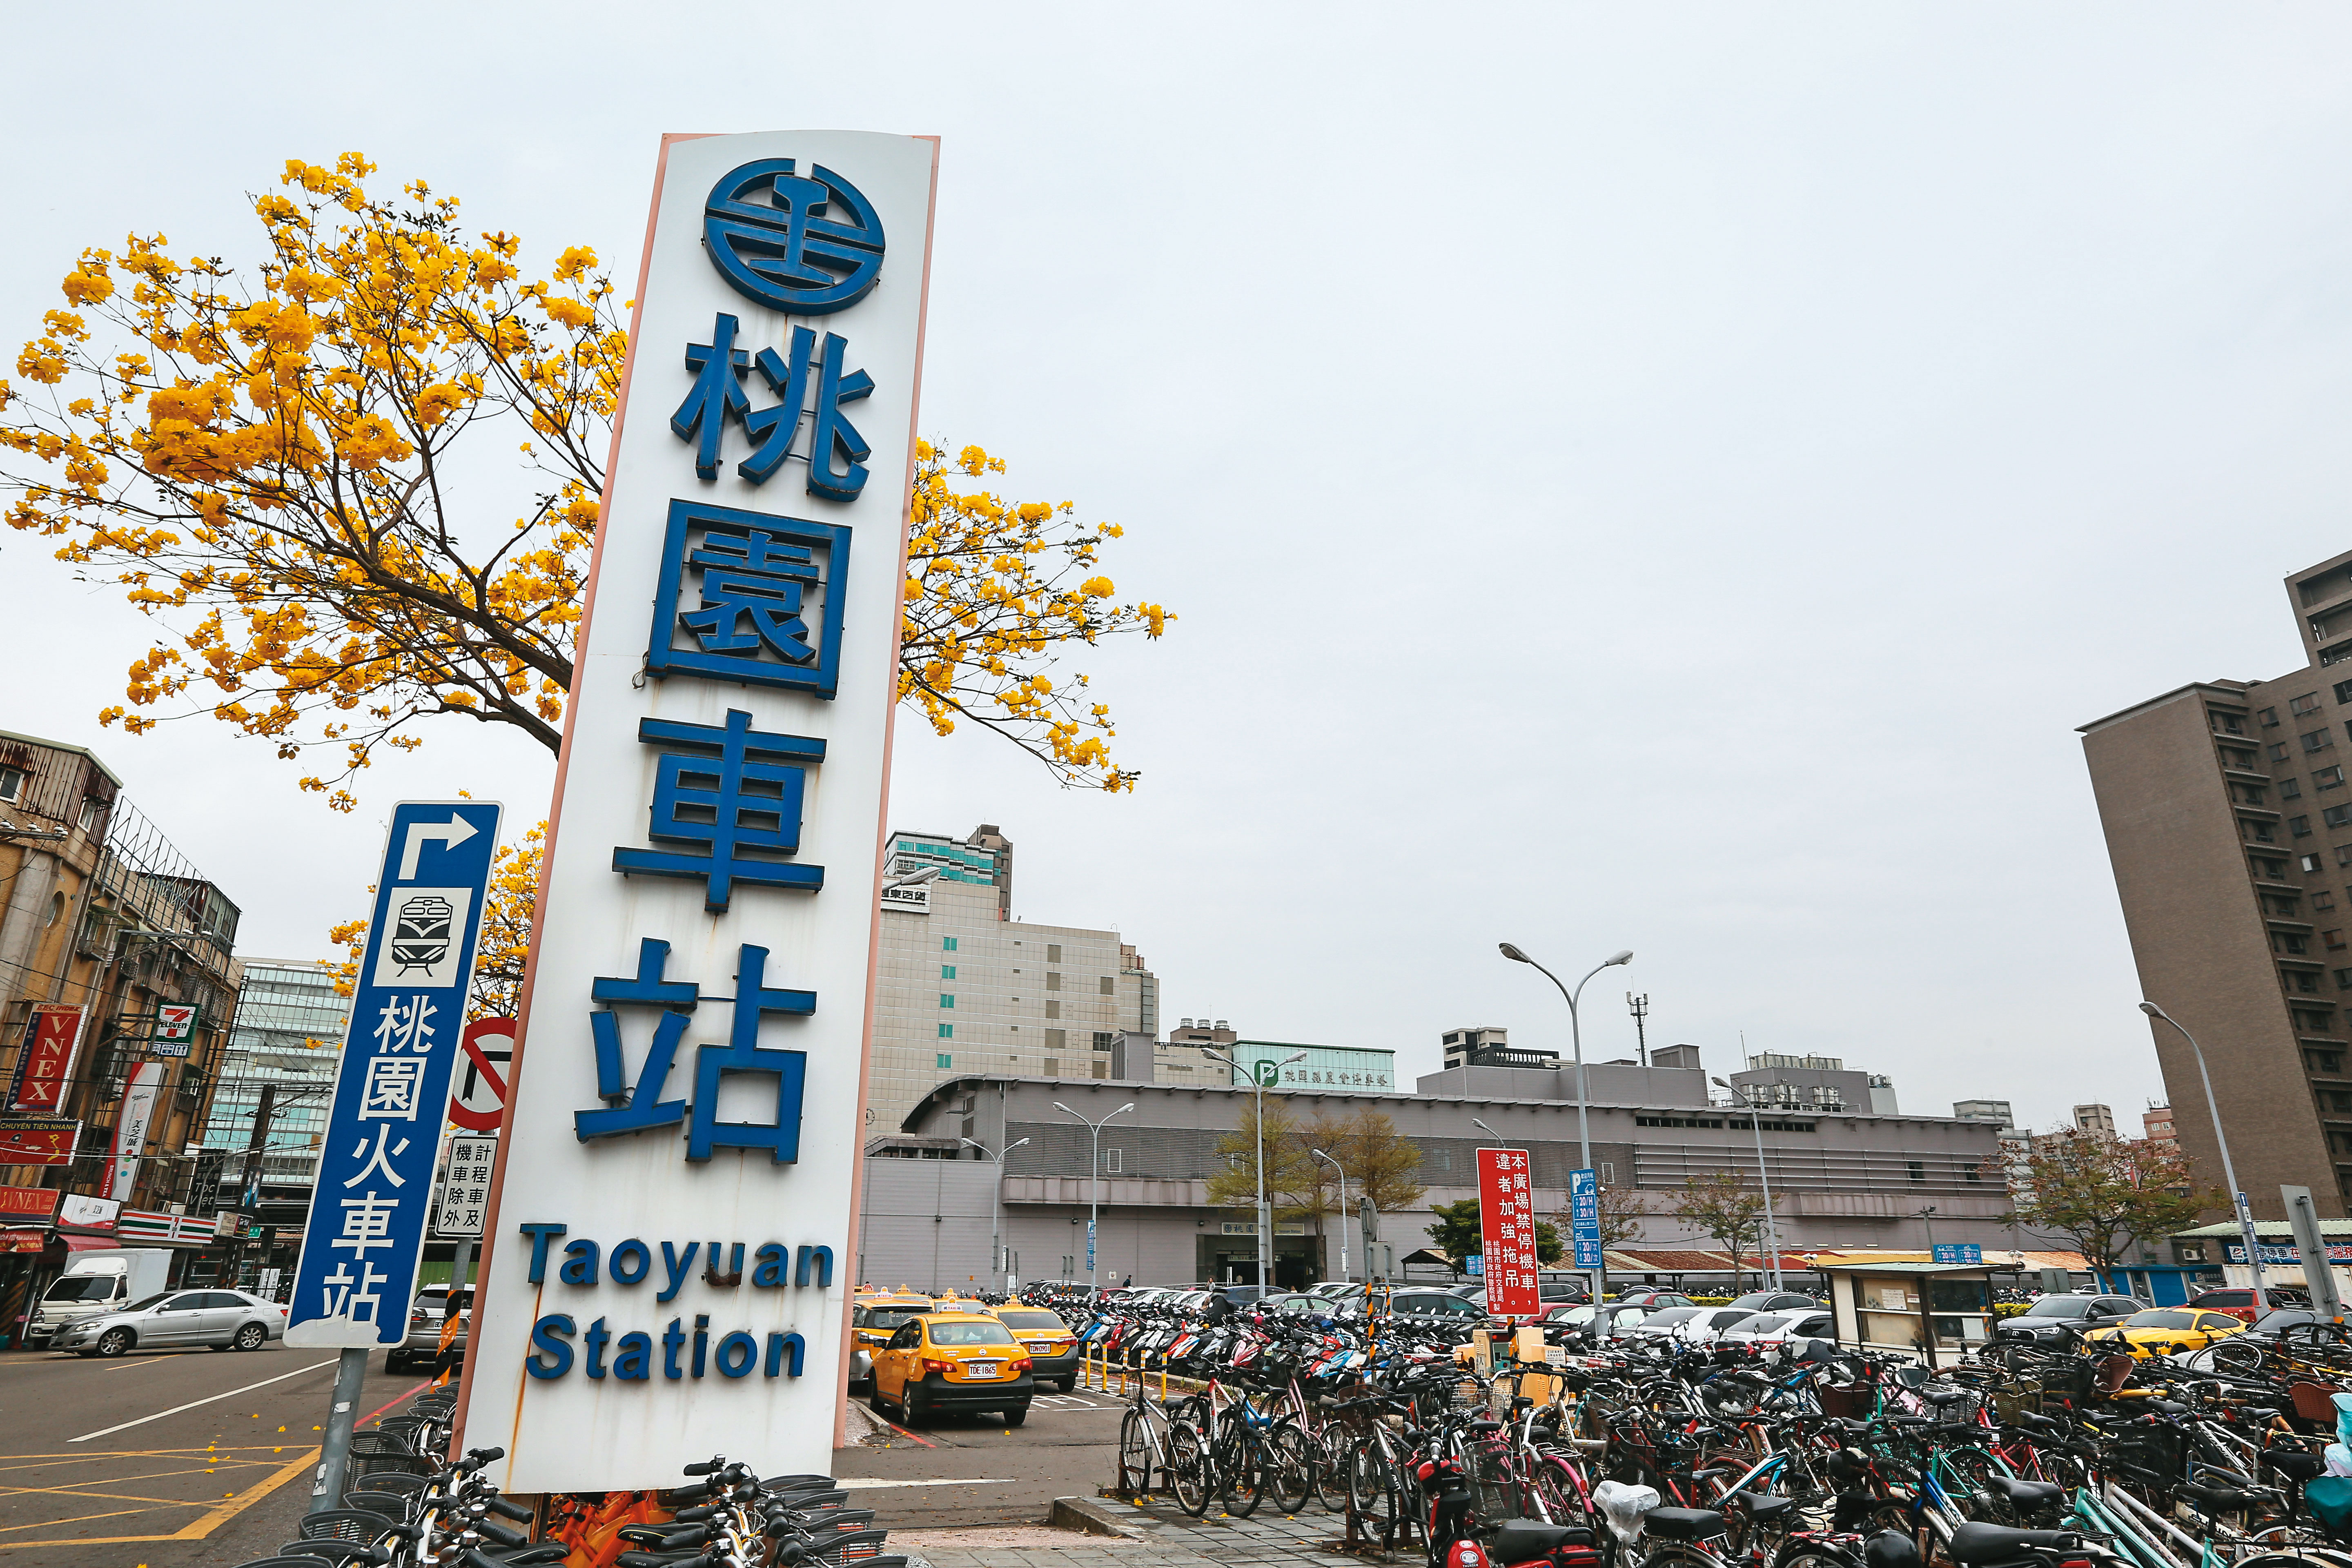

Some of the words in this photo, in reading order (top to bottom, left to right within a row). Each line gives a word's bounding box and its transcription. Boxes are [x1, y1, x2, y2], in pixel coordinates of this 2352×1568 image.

[573, 312, 875, 1165] 桃園車站
[27, 1016, 72, 1100] VNEX
[9, 1191, 41, 1210] VNEX
[190, 1194, 214, 1207] Vệt
[316, 995, 438, 1329] 桃園火車站
[443, 1144, 472, 1227] 機車除外
[463, 1144, 491, 1227] 計程車及
[1579, 1196, 1593, 1206] 20/H
[1579, 1207, 1594, 1218] 30/H
[519, 1223, 834, 1302] Taoyuan
[525, 1314, 805, 1379] Station
